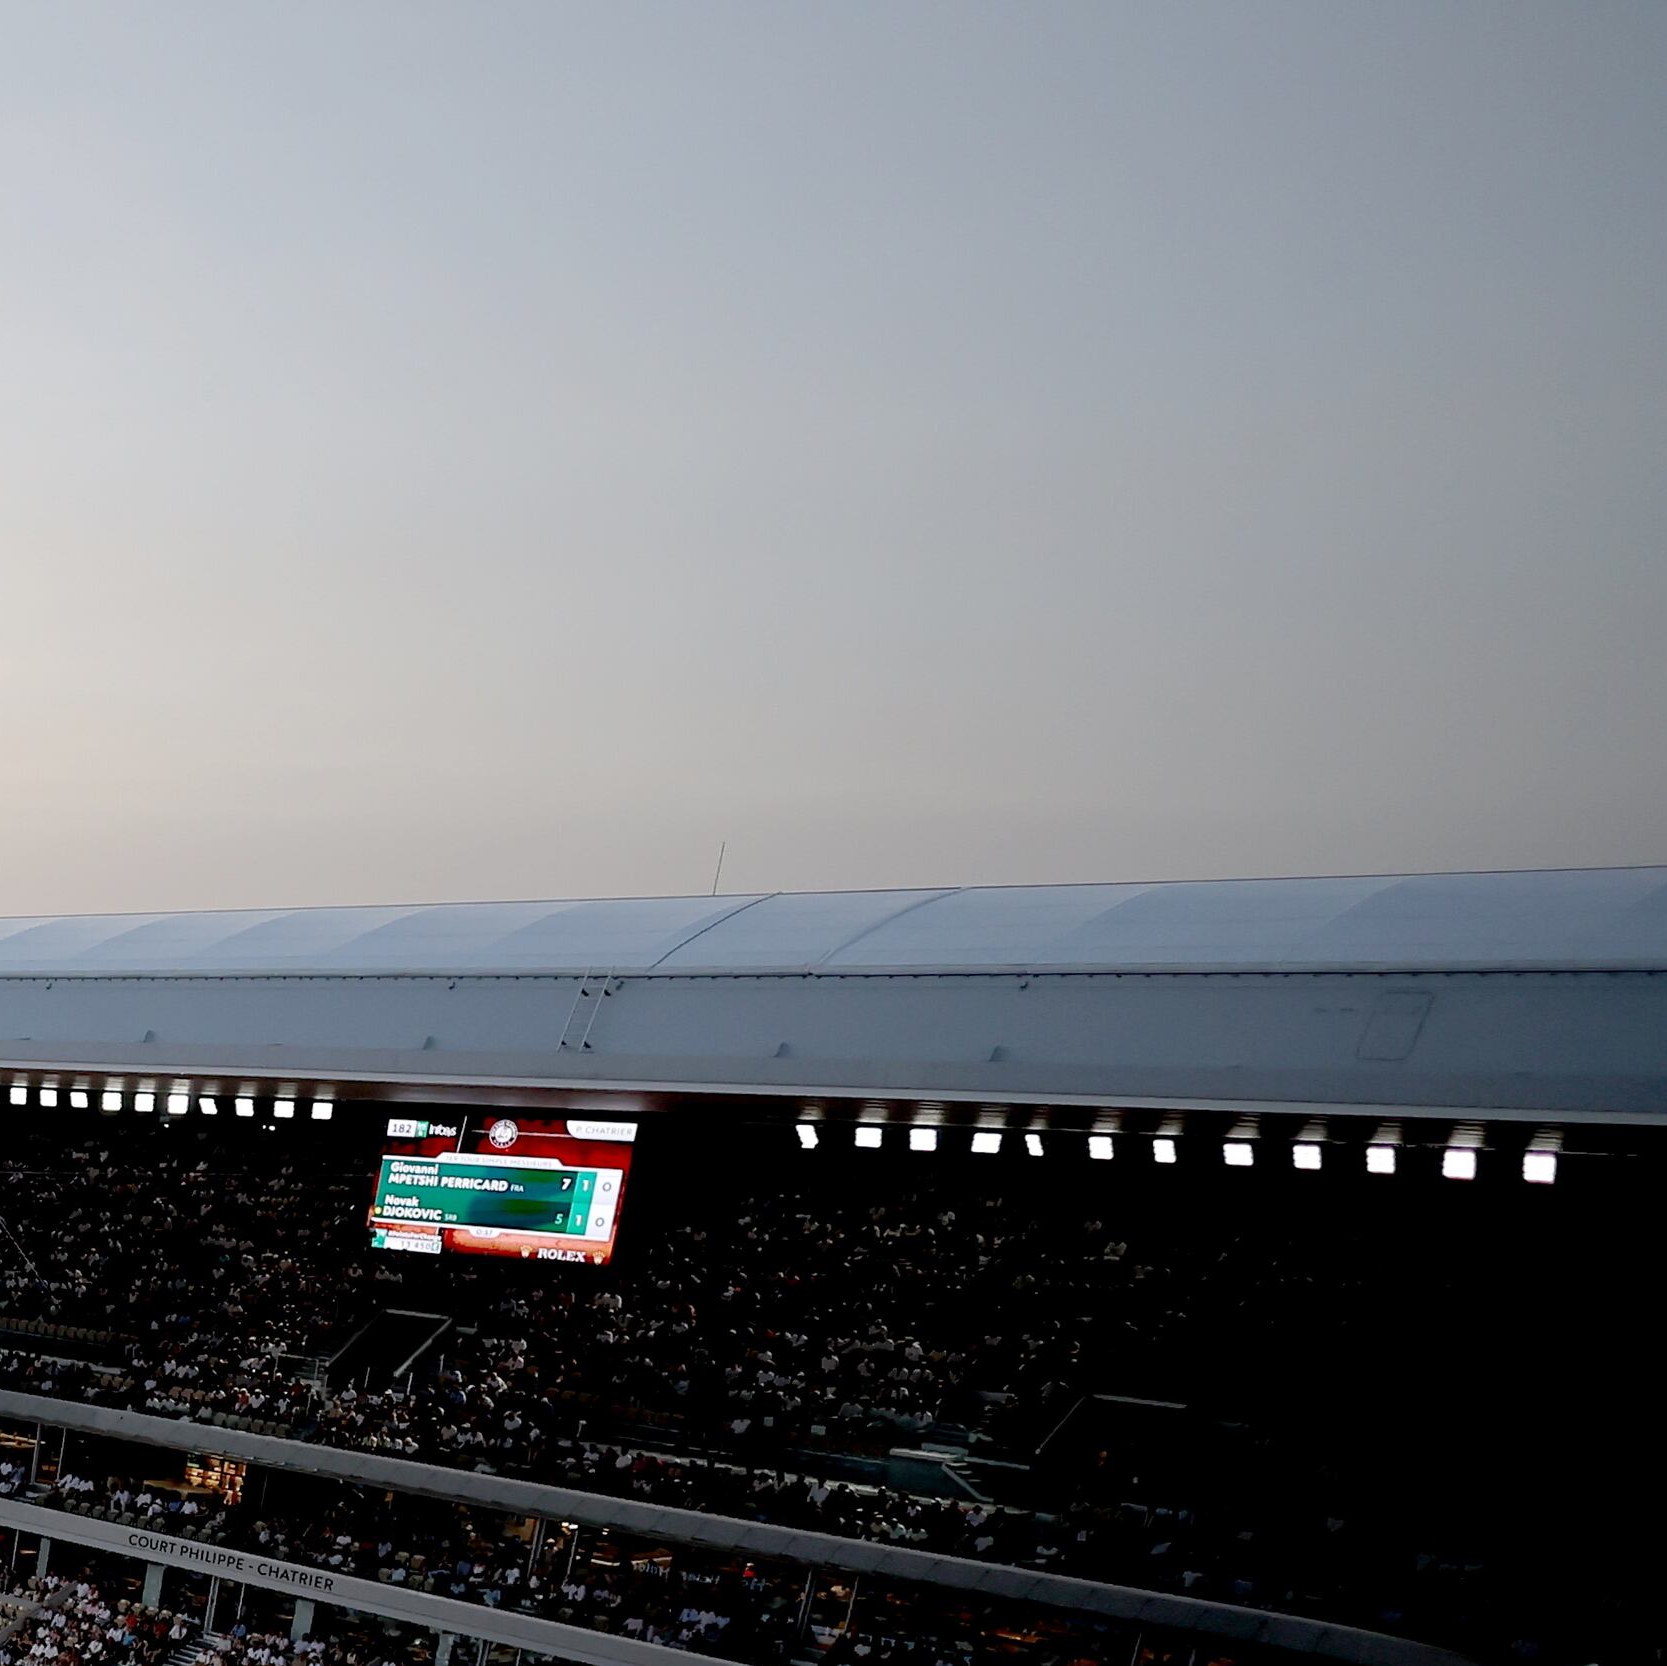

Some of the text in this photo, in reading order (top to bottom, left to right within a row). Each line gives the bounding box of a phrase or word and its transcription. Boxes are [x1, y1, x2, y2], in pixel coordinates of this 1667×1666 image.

[393, 1123, 412, 1133] 182
[585, 1126, 633, 1136] CHATRIER
[390, 1161, 439, 1175] Giovanni
[388, 1173, 524, 1192] MPETSHI PERRICARD FRA
[562, 1178, 572, 1190] 7
[583, 1179, 590, 1191] 1
[385, 1194, 419, 1207] Novak
[383, 1205, 443, 1220] DJOKOVIC
[554, 1213, 563, 1224] 5
[575, 1215, 583, 1226] 1
[537, 1247, 587, 1263] ROLEX
[128, 1533, 177, 1554] COURT
[179, 1544, 244, 1571] PHILIPPE
[257, 1563, 334, 1592] CHATRIER
